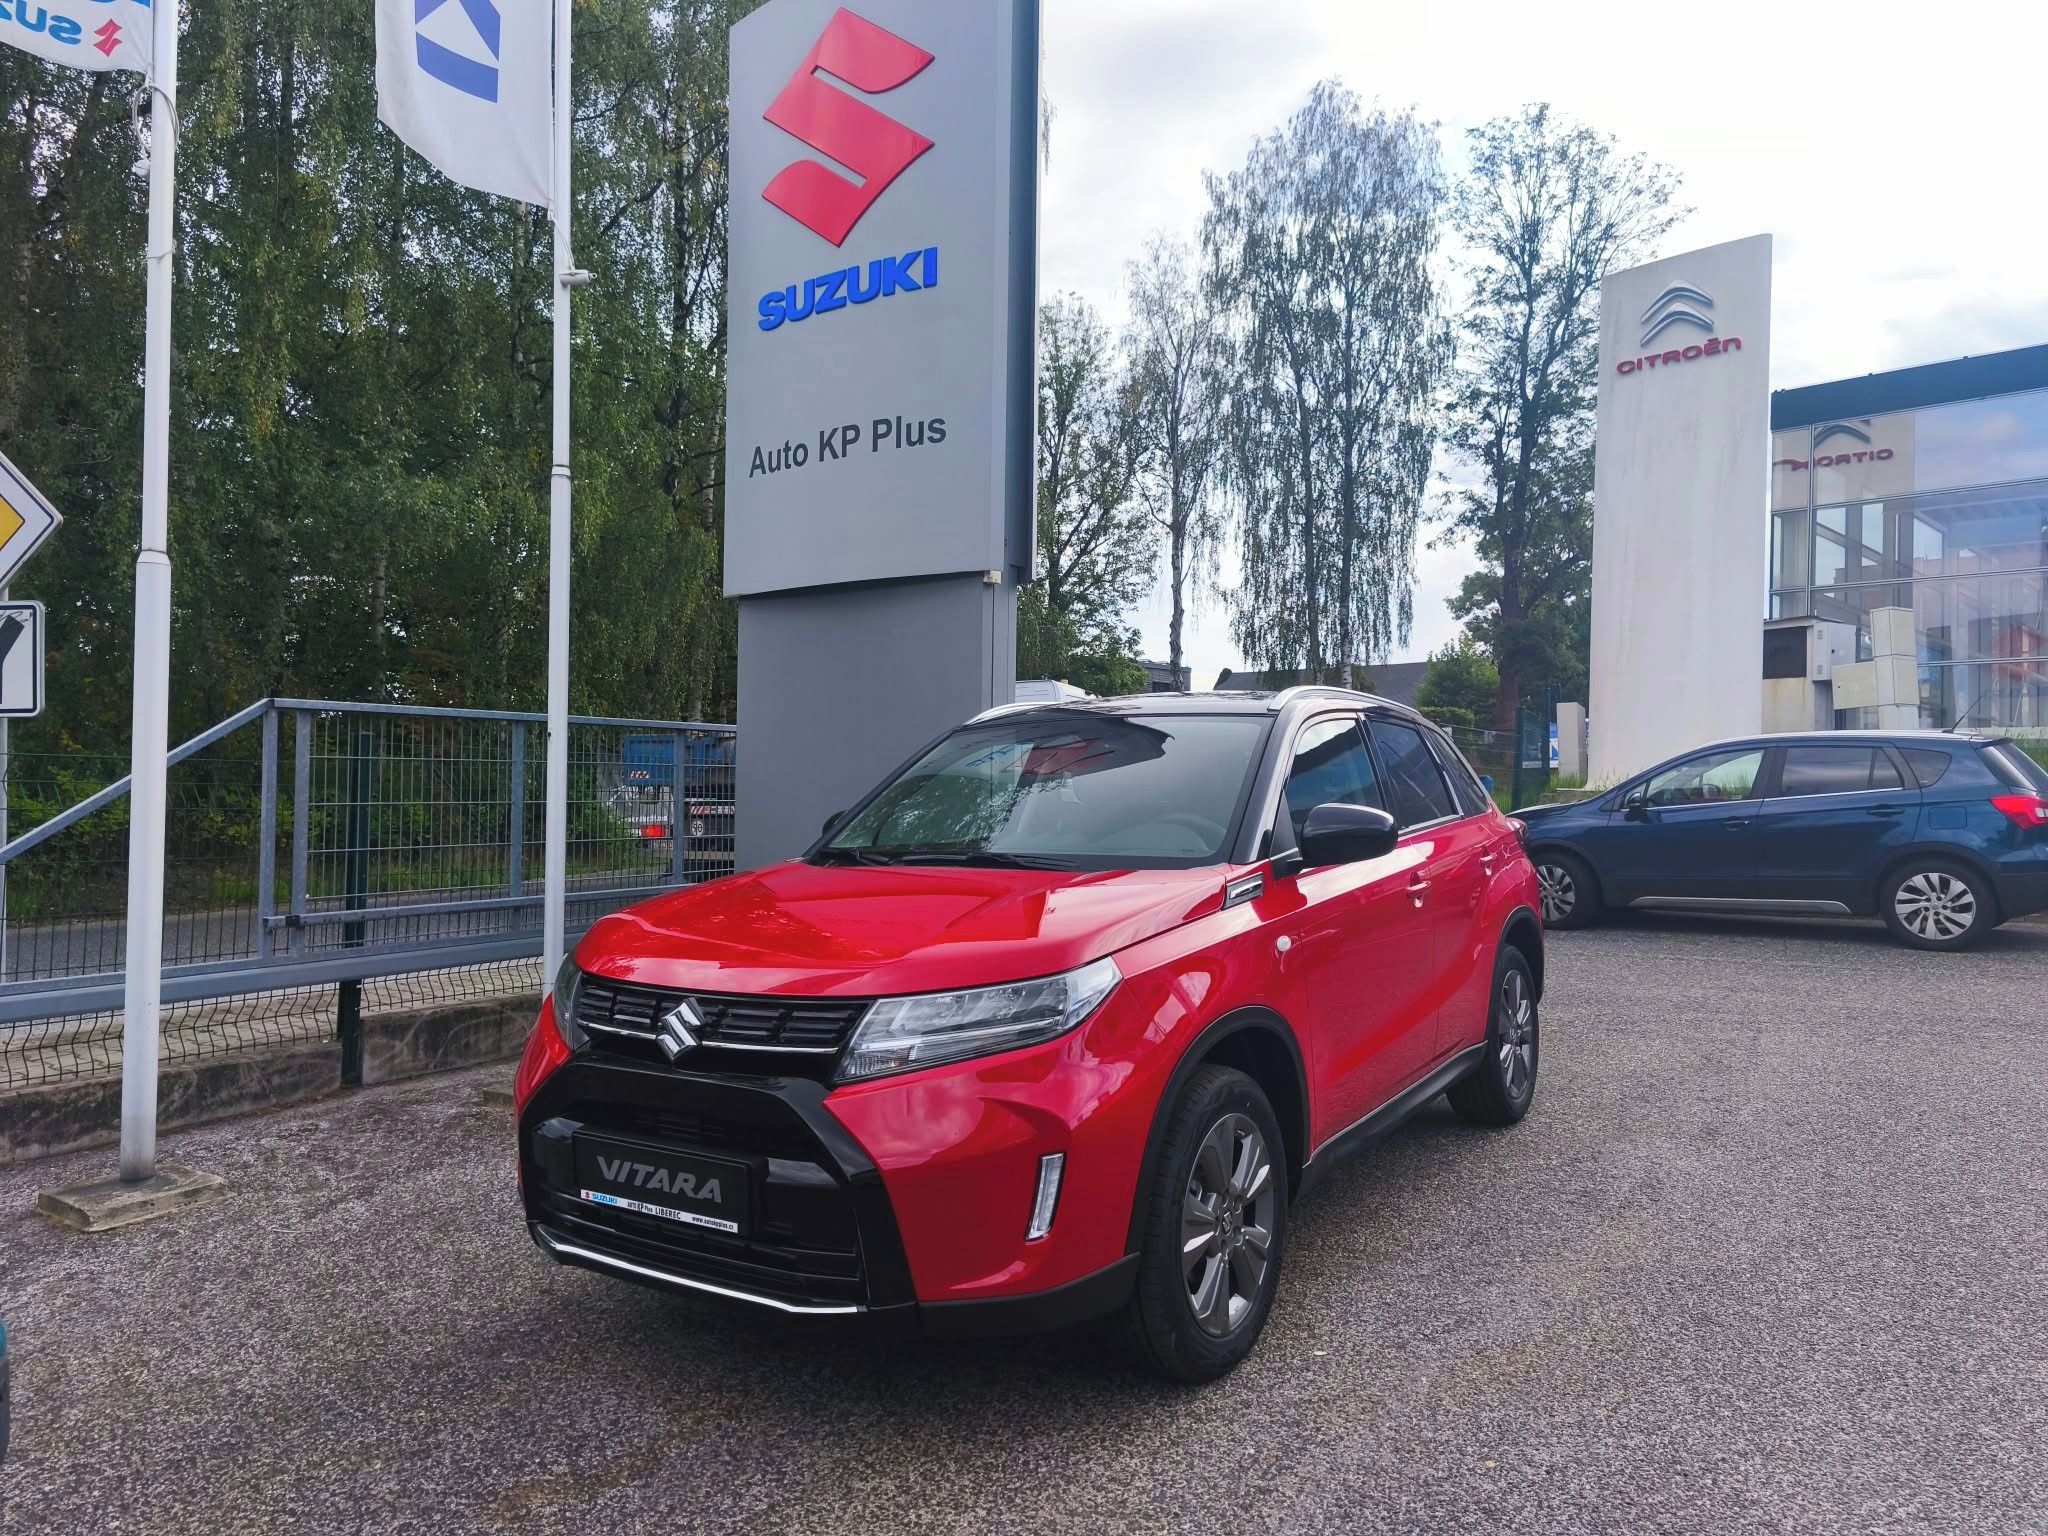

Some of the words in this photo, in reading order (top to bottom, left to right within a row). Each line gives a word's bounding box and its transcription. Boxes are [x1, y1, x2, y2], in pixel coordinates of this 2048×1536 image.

[758, 247, 938, 331] SUZUKI
[749, 440, 809, 478] Auto
[819, 424, 861, 462] KP
[872, 416, 947, 453] Plus
[592, 1193, 618, 1204] SUZUKI
[655, 1207, 681, 1219] LIBEREC
[597, 1155, 722, 1203] VITARA
